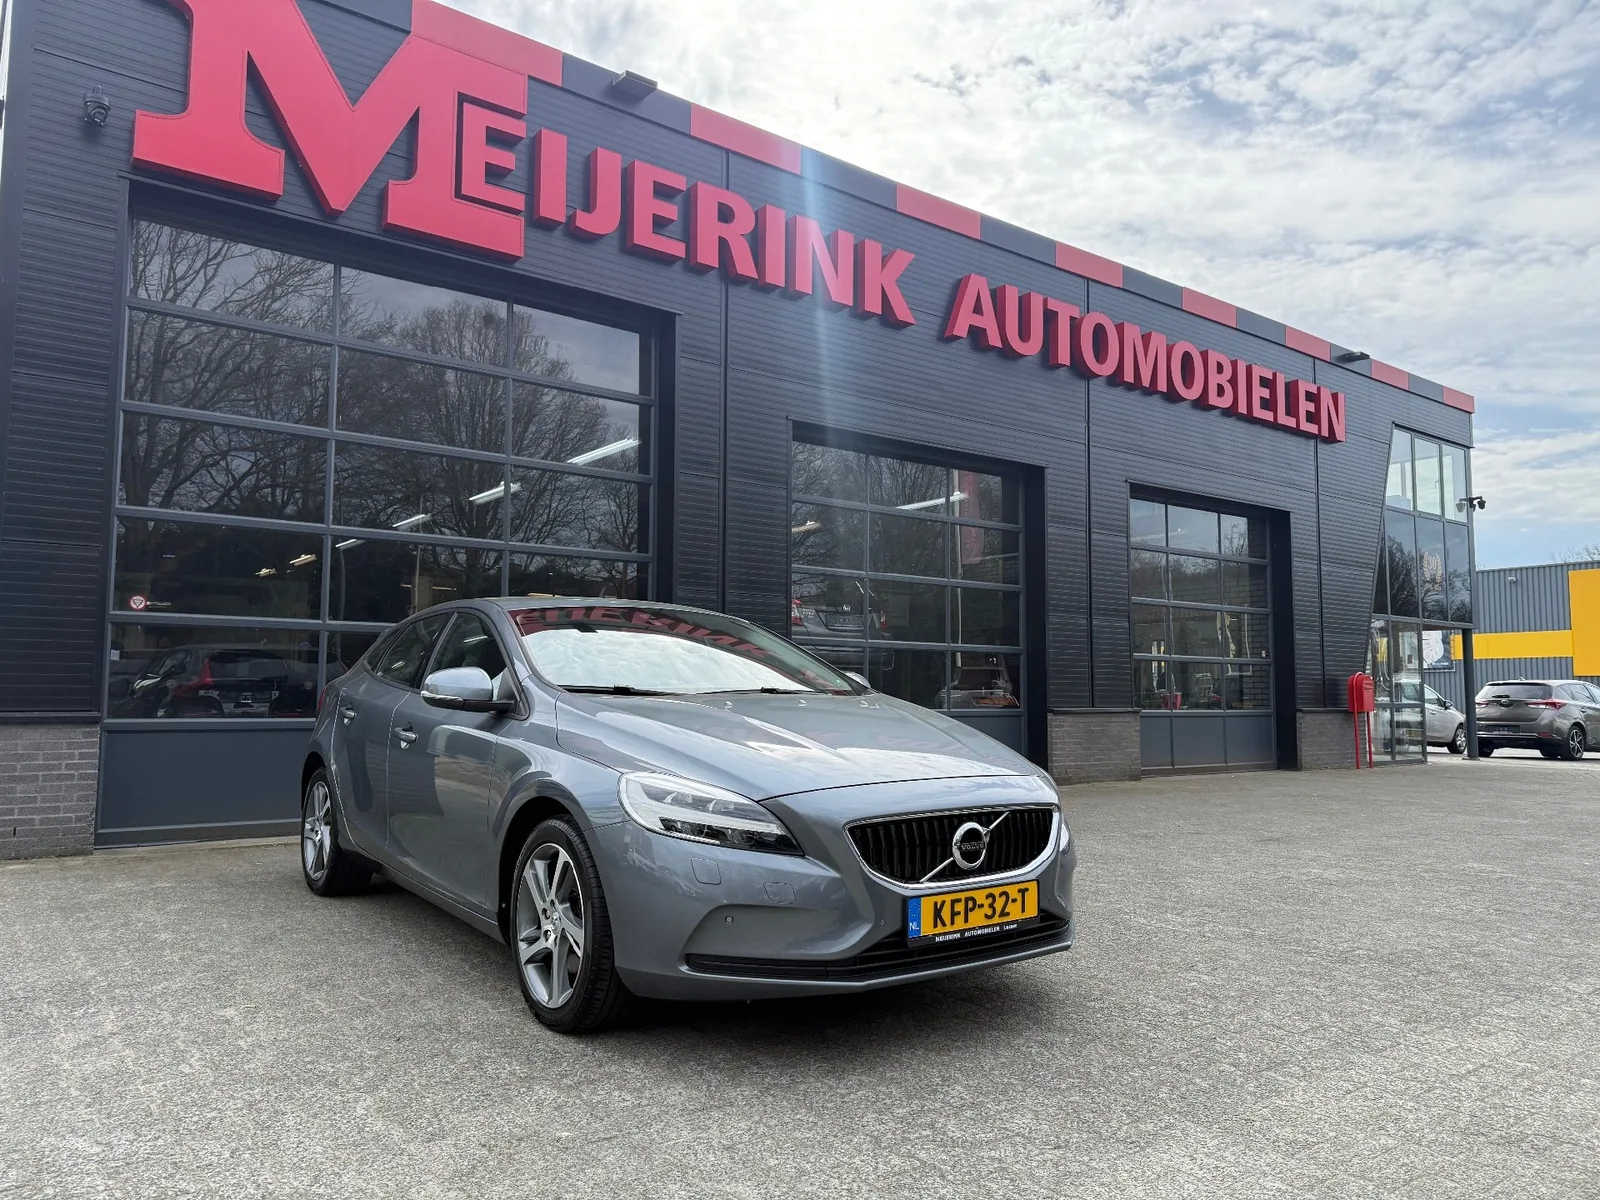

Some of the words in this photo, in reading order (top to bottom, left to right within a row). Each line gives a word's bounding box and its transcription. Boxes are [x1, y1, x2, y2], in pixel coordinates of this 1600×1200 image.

[132, 0, 916, 328] MEIJERINK
[944, 271, 1346, 442] AUTOMOBIELEN
[909, 921, 920, 931] NL
[932, 887, 1030, 929] KFP-32-T
